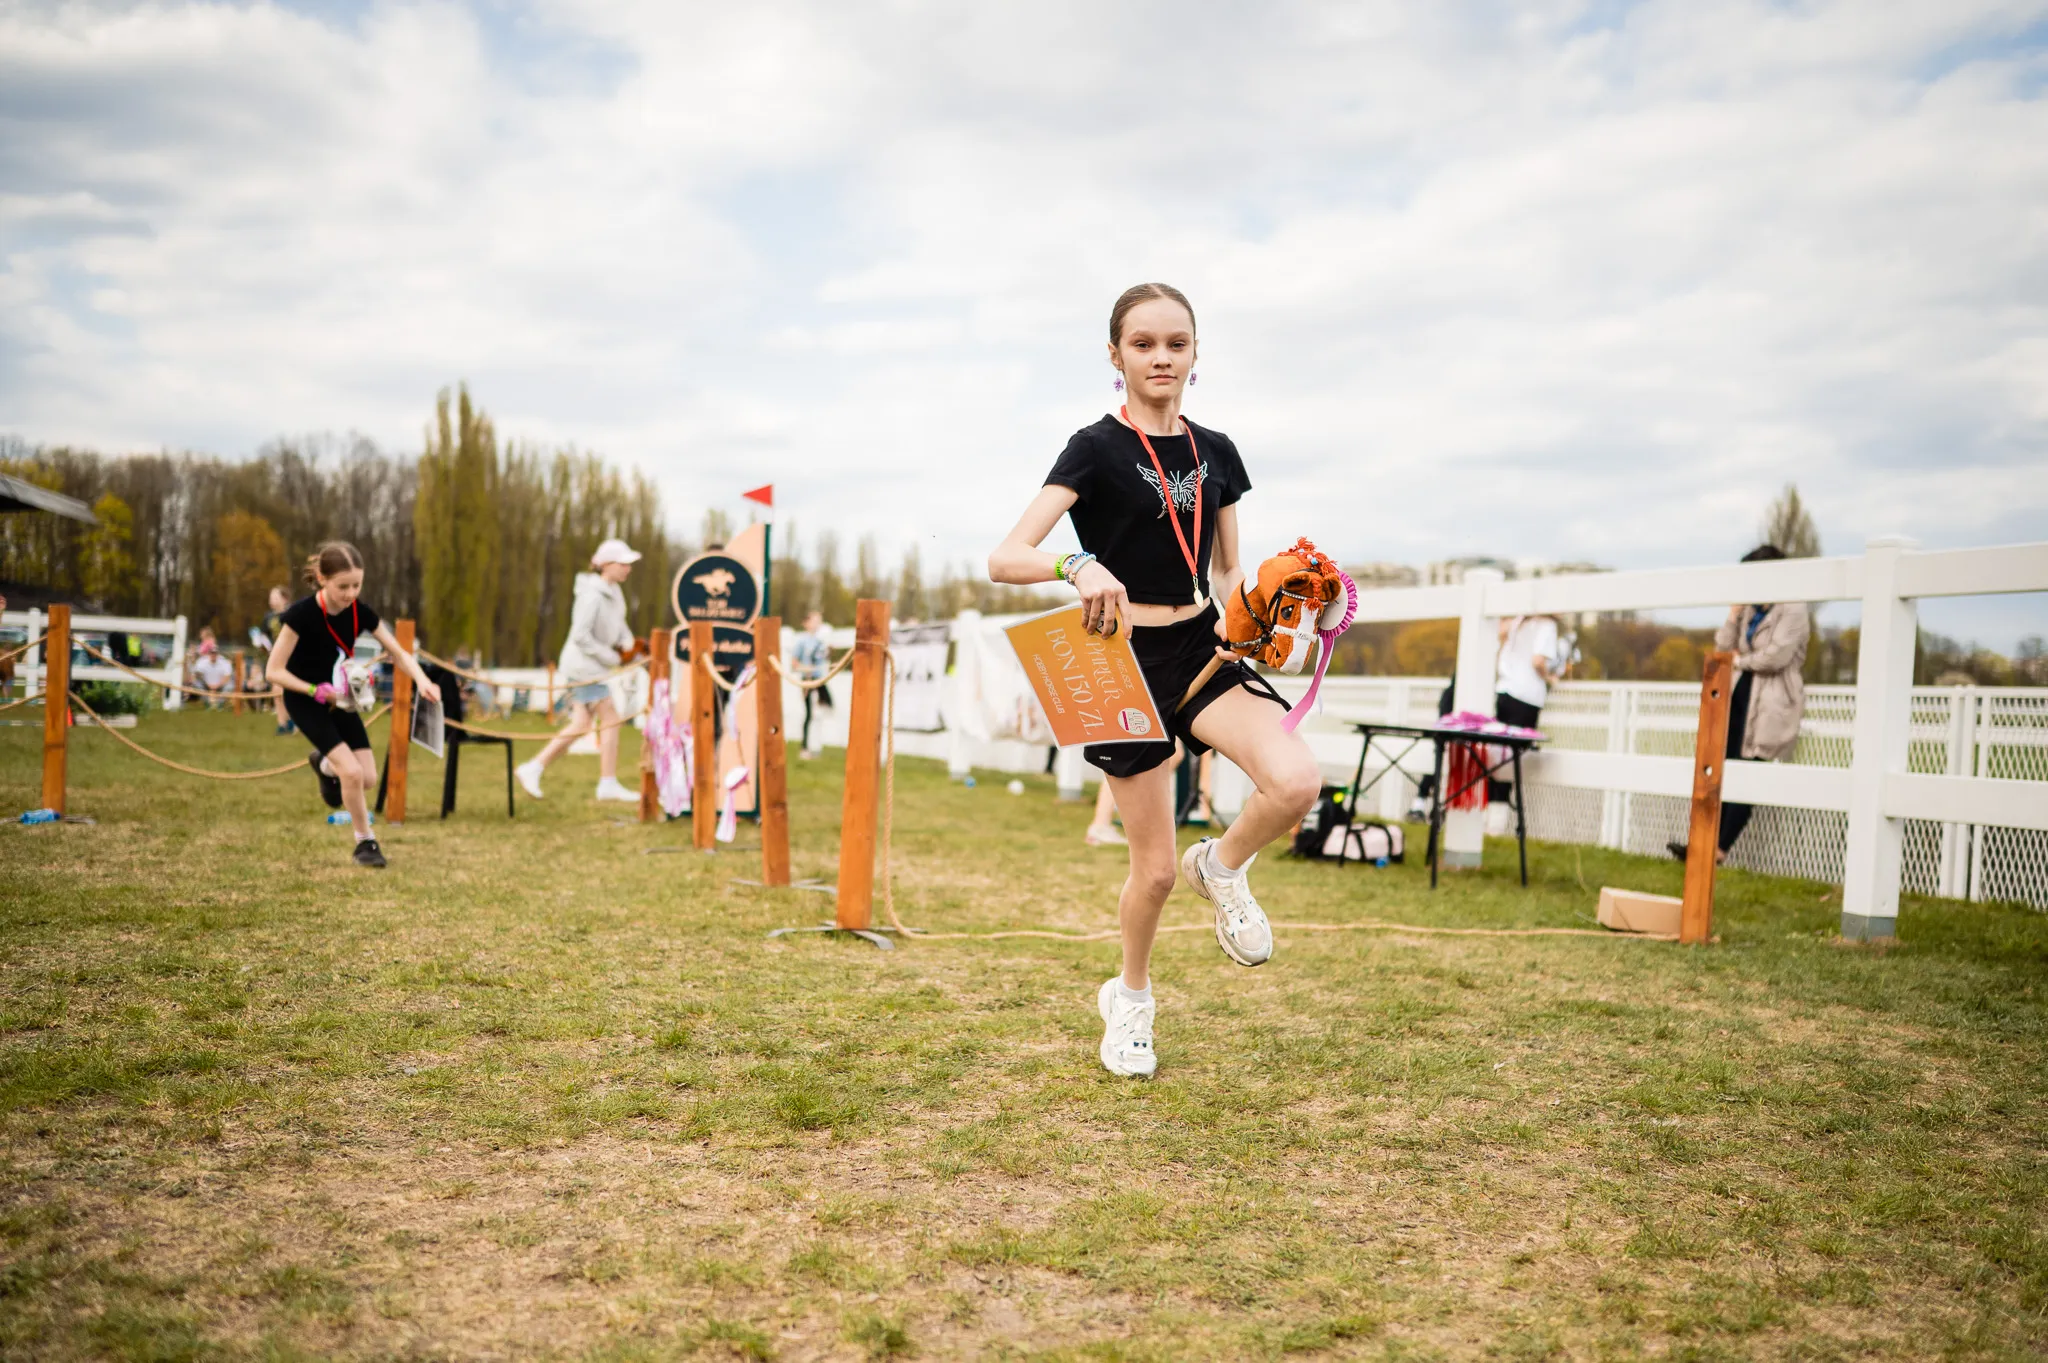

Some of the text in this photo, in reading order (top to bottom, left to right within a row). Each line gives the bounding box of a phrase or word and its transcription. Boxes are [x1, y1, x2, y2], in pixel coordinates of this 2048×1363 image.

[1042, 675, 1056, 697] HORSE
[1046, 627, 1080, 671] BON
[1064, 674, 1094, 704] 150
